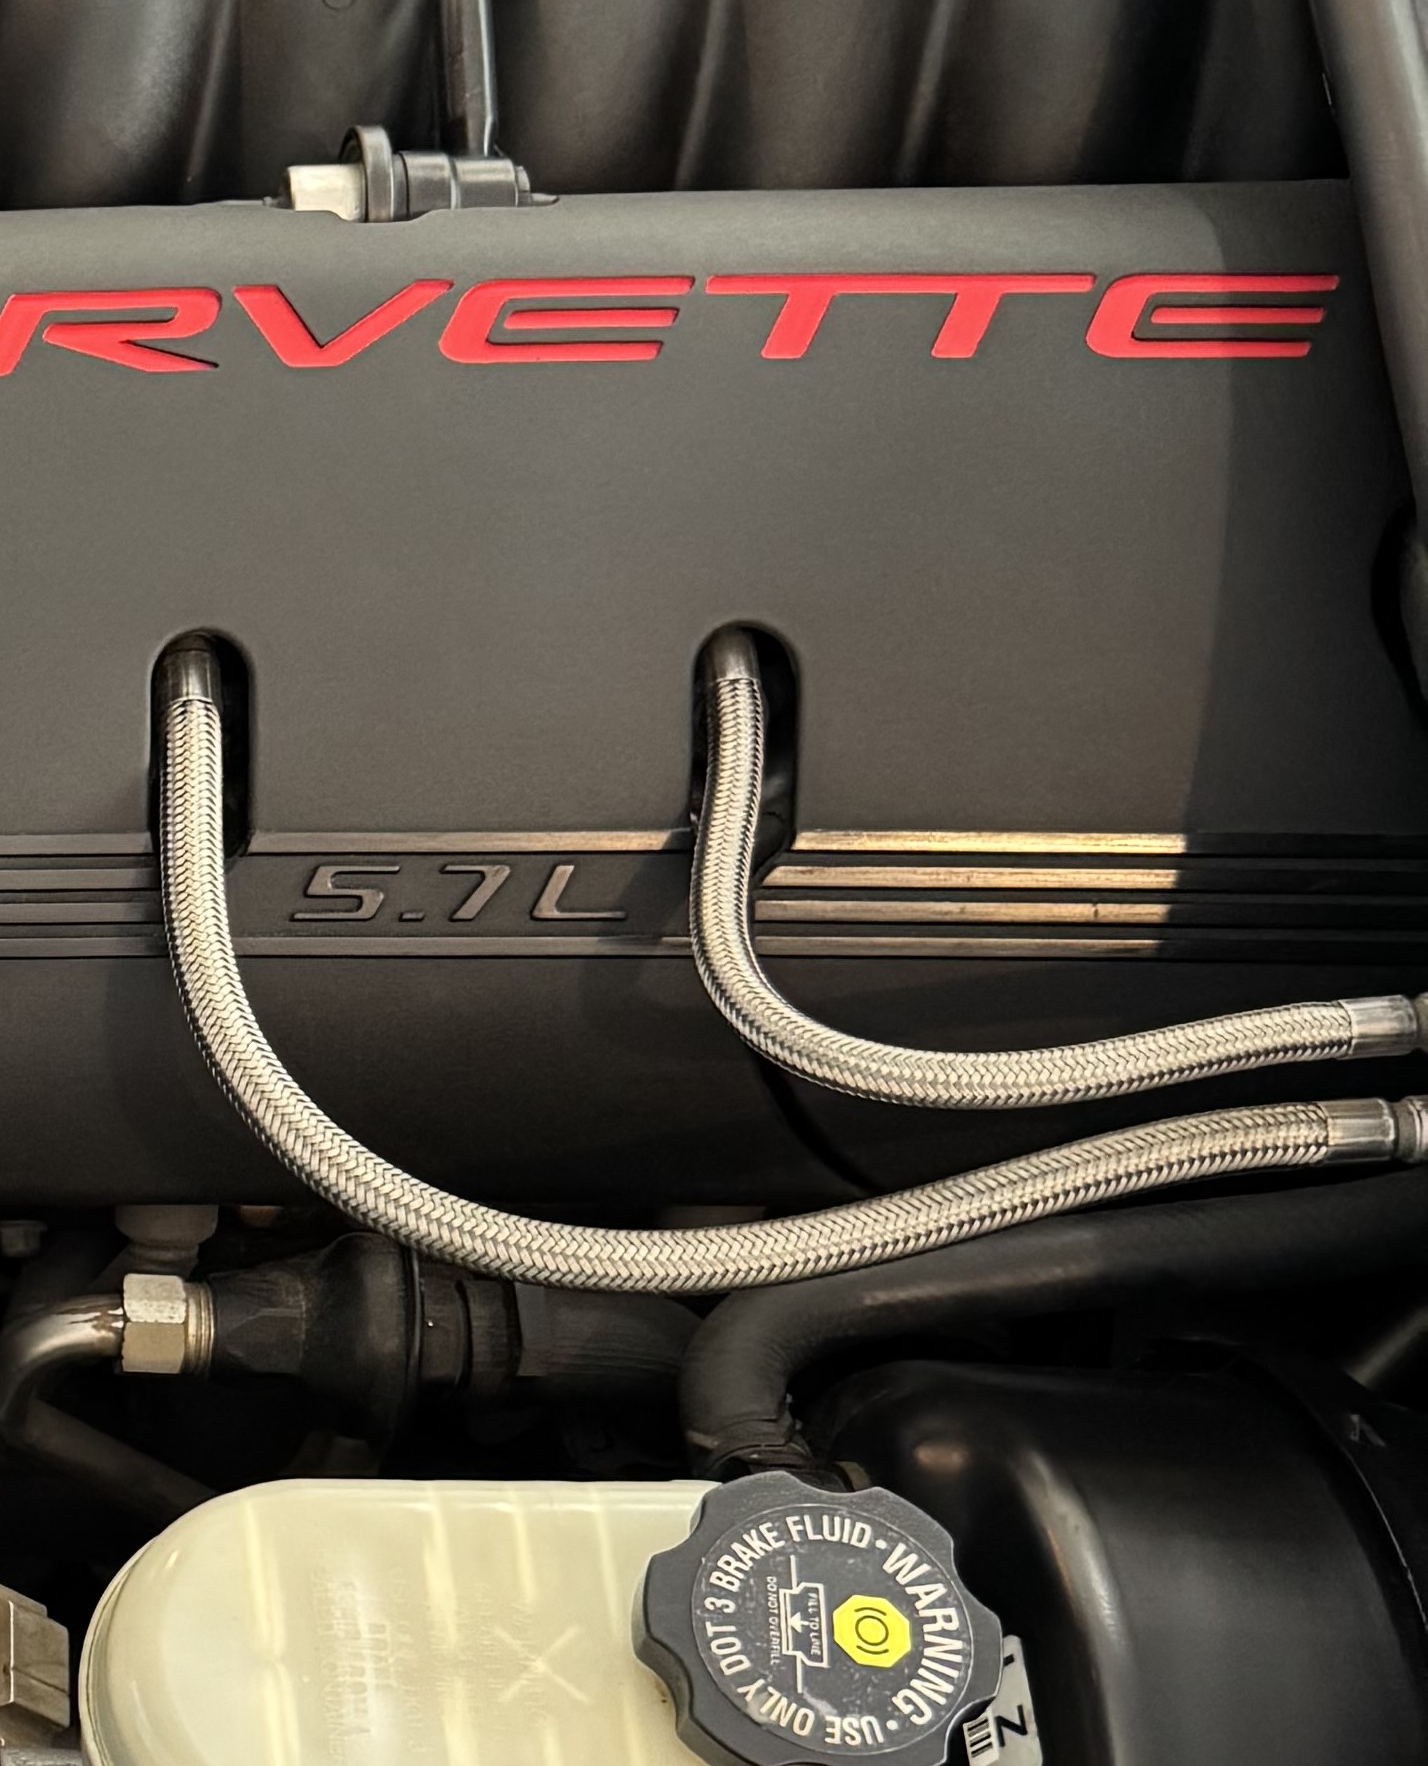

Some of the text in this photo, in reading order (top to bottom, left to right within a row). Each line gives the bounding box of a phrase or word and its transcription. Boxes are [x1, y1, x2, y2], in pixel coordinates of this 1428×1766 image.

[289, 864, 627, 922] 5.7L
[707, 1514, 885, 1746] USE ONLY DOT 3 BRAKE FLUID
[880, 1541, 965, 1726] WARNING
